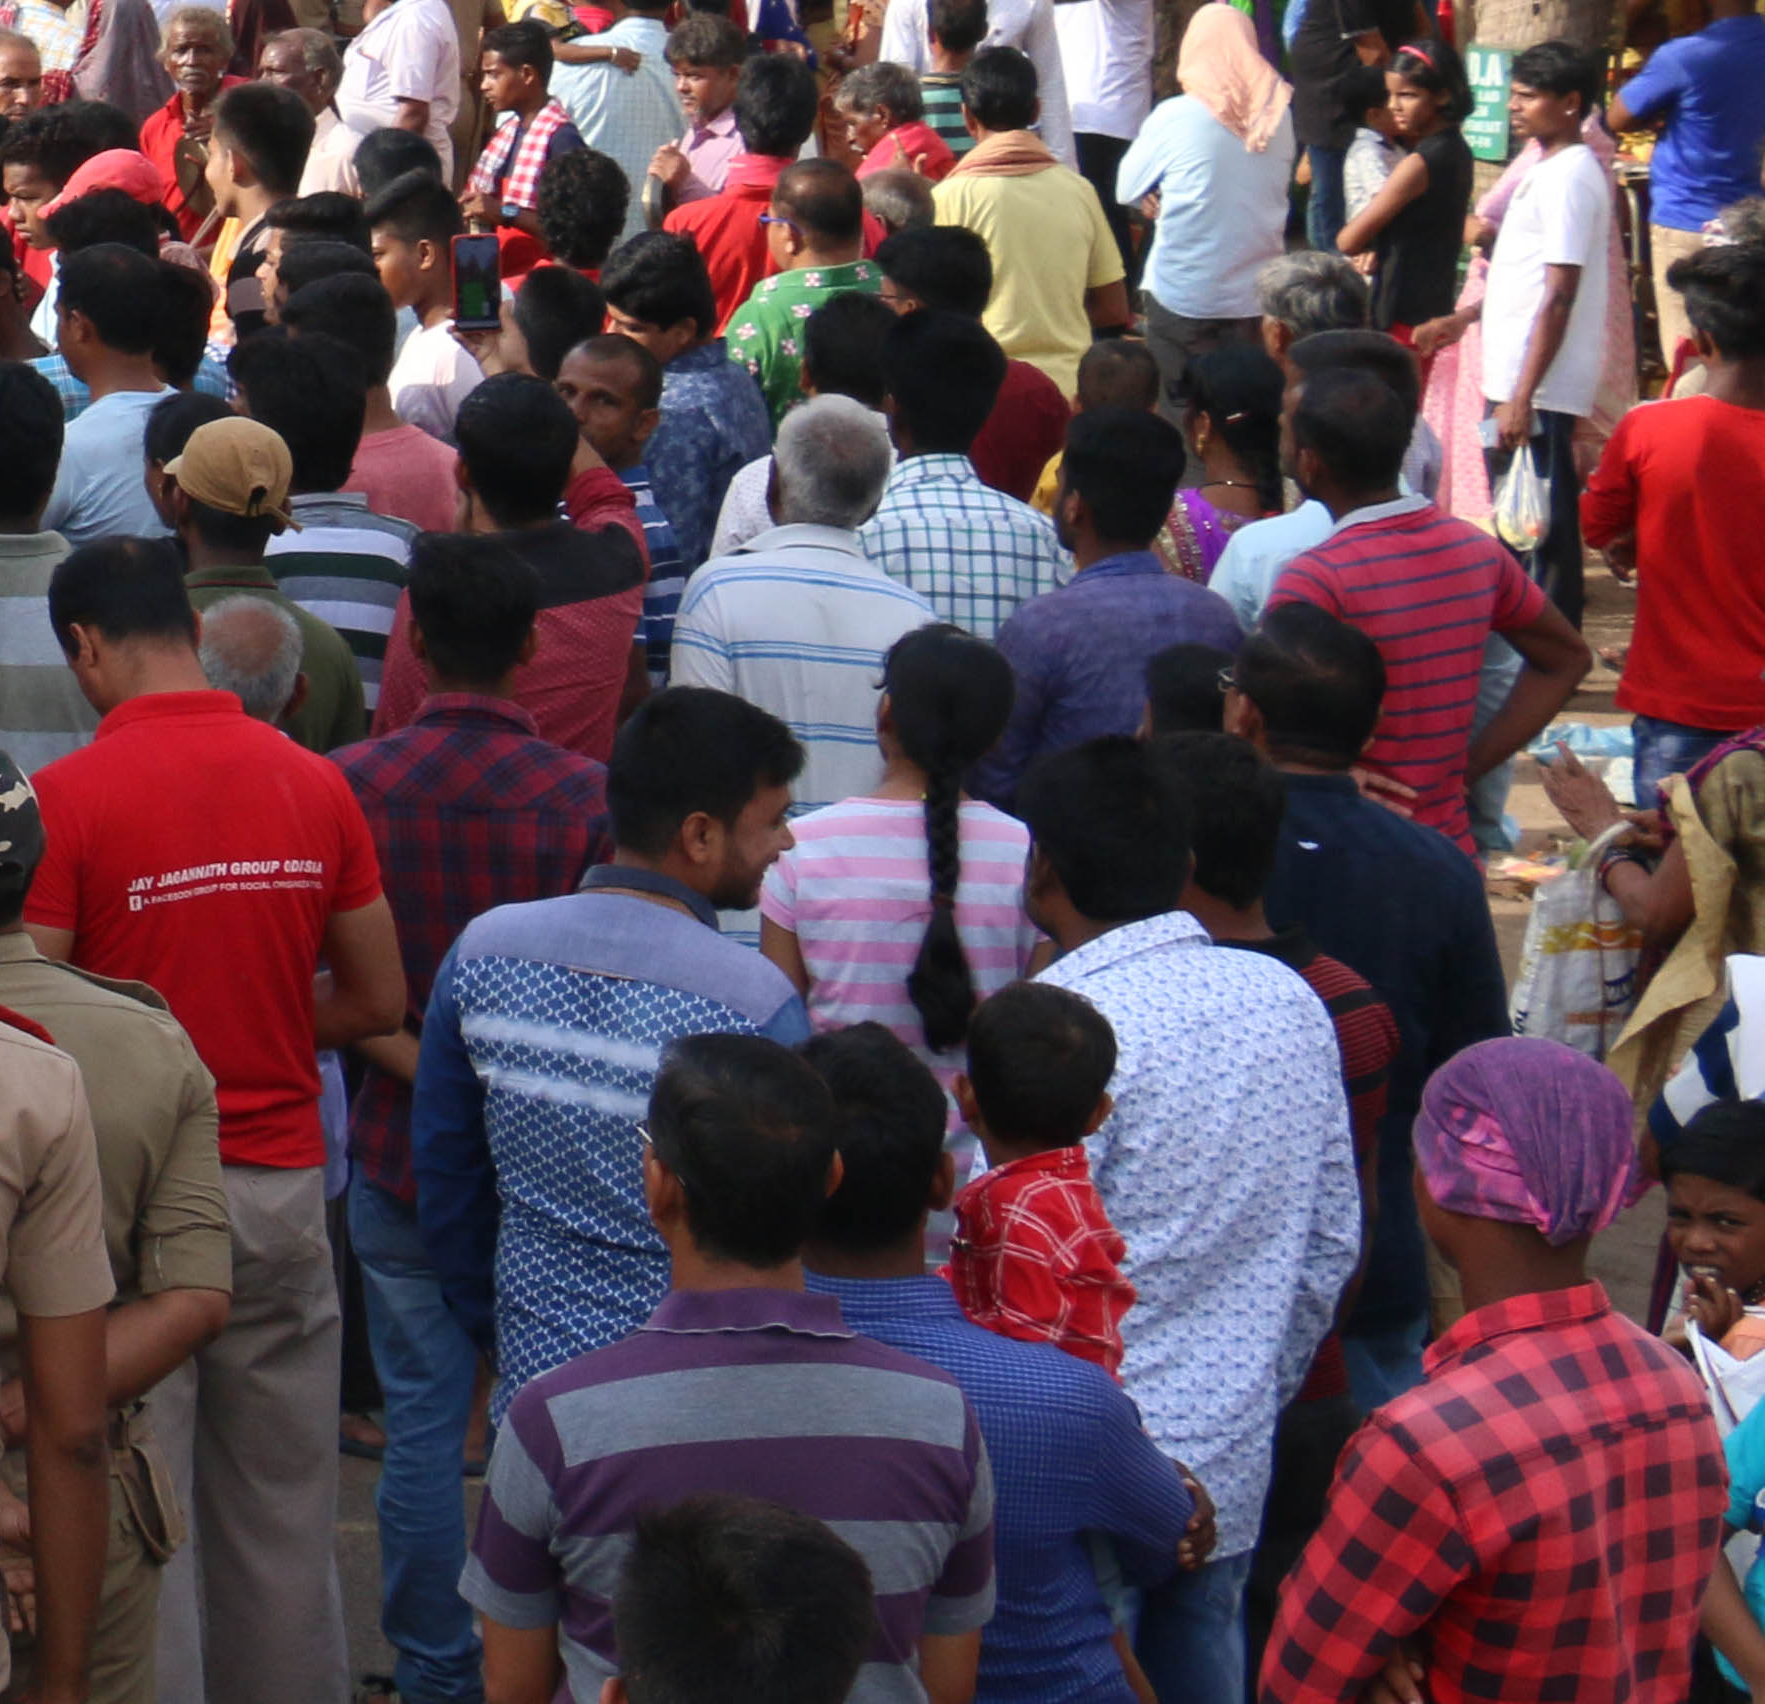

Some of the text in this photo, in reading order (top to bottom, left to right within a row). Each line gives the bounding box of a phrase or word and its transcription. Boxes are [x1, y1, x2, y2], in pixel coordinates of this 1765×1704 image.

[127, 876, 154, 892] JAY
[157, 862, 227, 887] JAGANNATH
[230, 860, 280, 876] GROUP
[220, 881, 239, 892] FOR
[240, 880, 272, 891] SOCIAL
